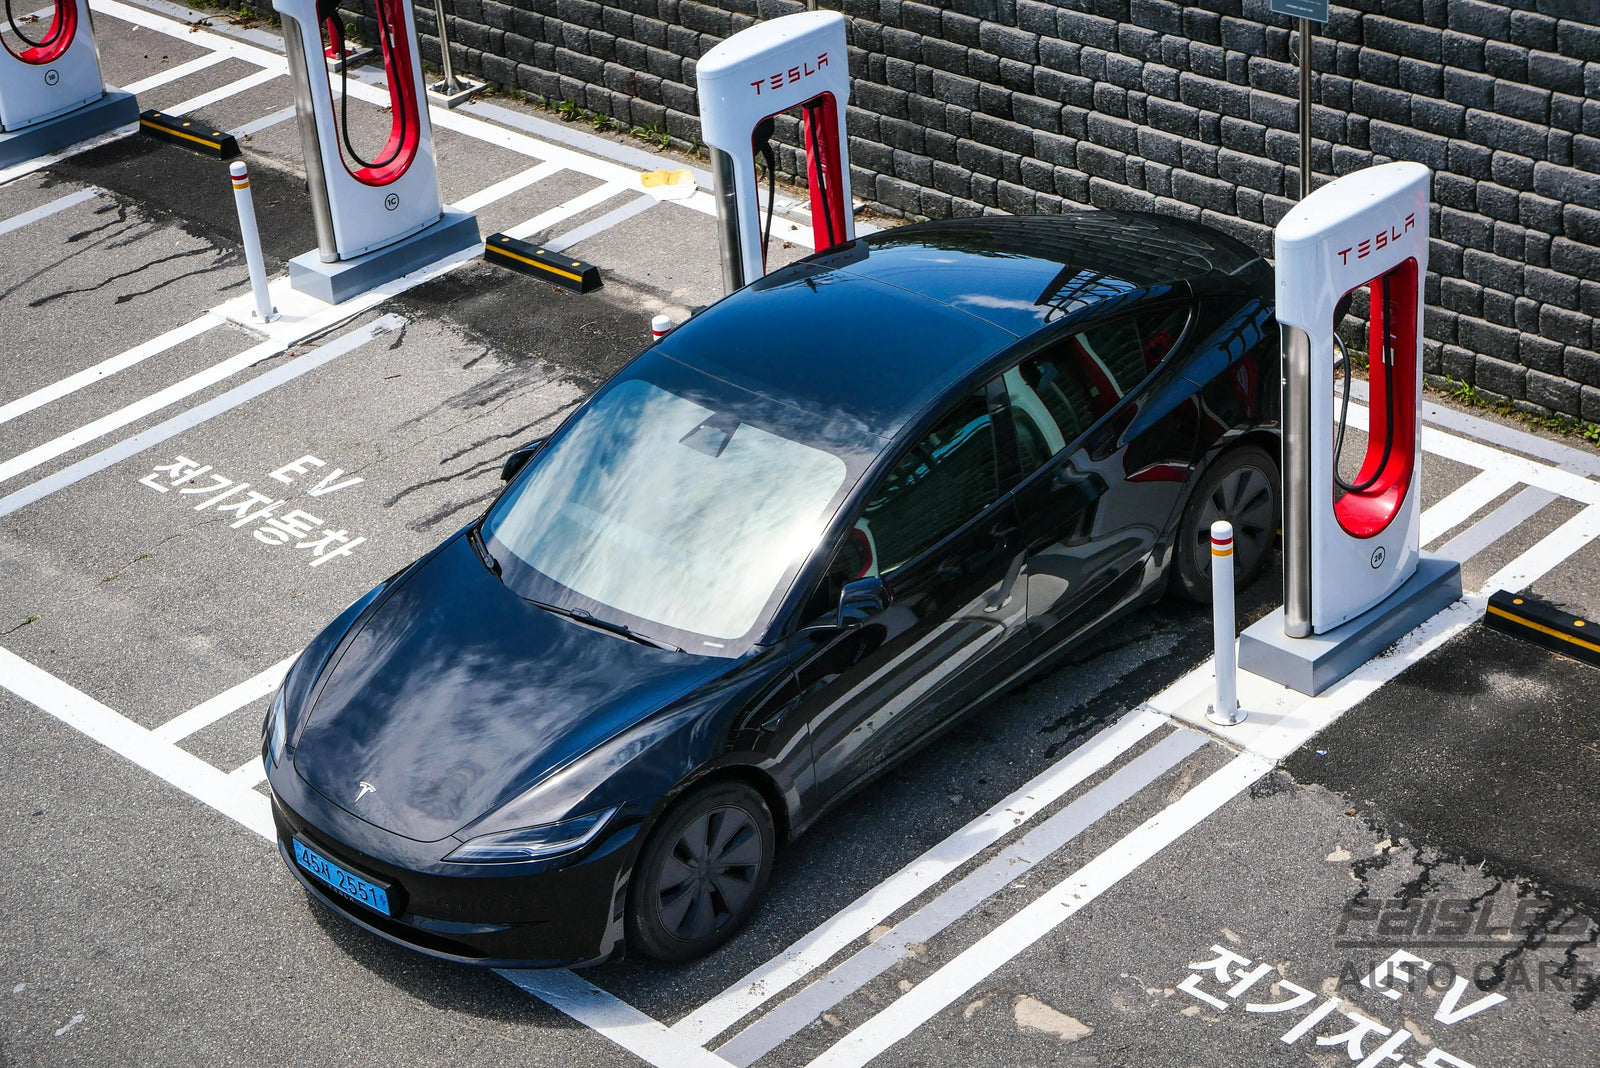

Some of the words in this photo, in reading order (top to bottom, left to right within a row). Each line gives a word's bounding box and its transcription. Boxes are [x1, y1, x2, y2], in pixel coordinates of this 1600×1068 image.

[750, 52, 828, 95] TESLA
[1337, 213, 1415, 265] TESLA
[268, 454, 365, 497] EV
[138, 455, 367, 567] 전기자동차
[336, 870, 377, 906] 2551
[1361, 949, 1508, 1025] EV
